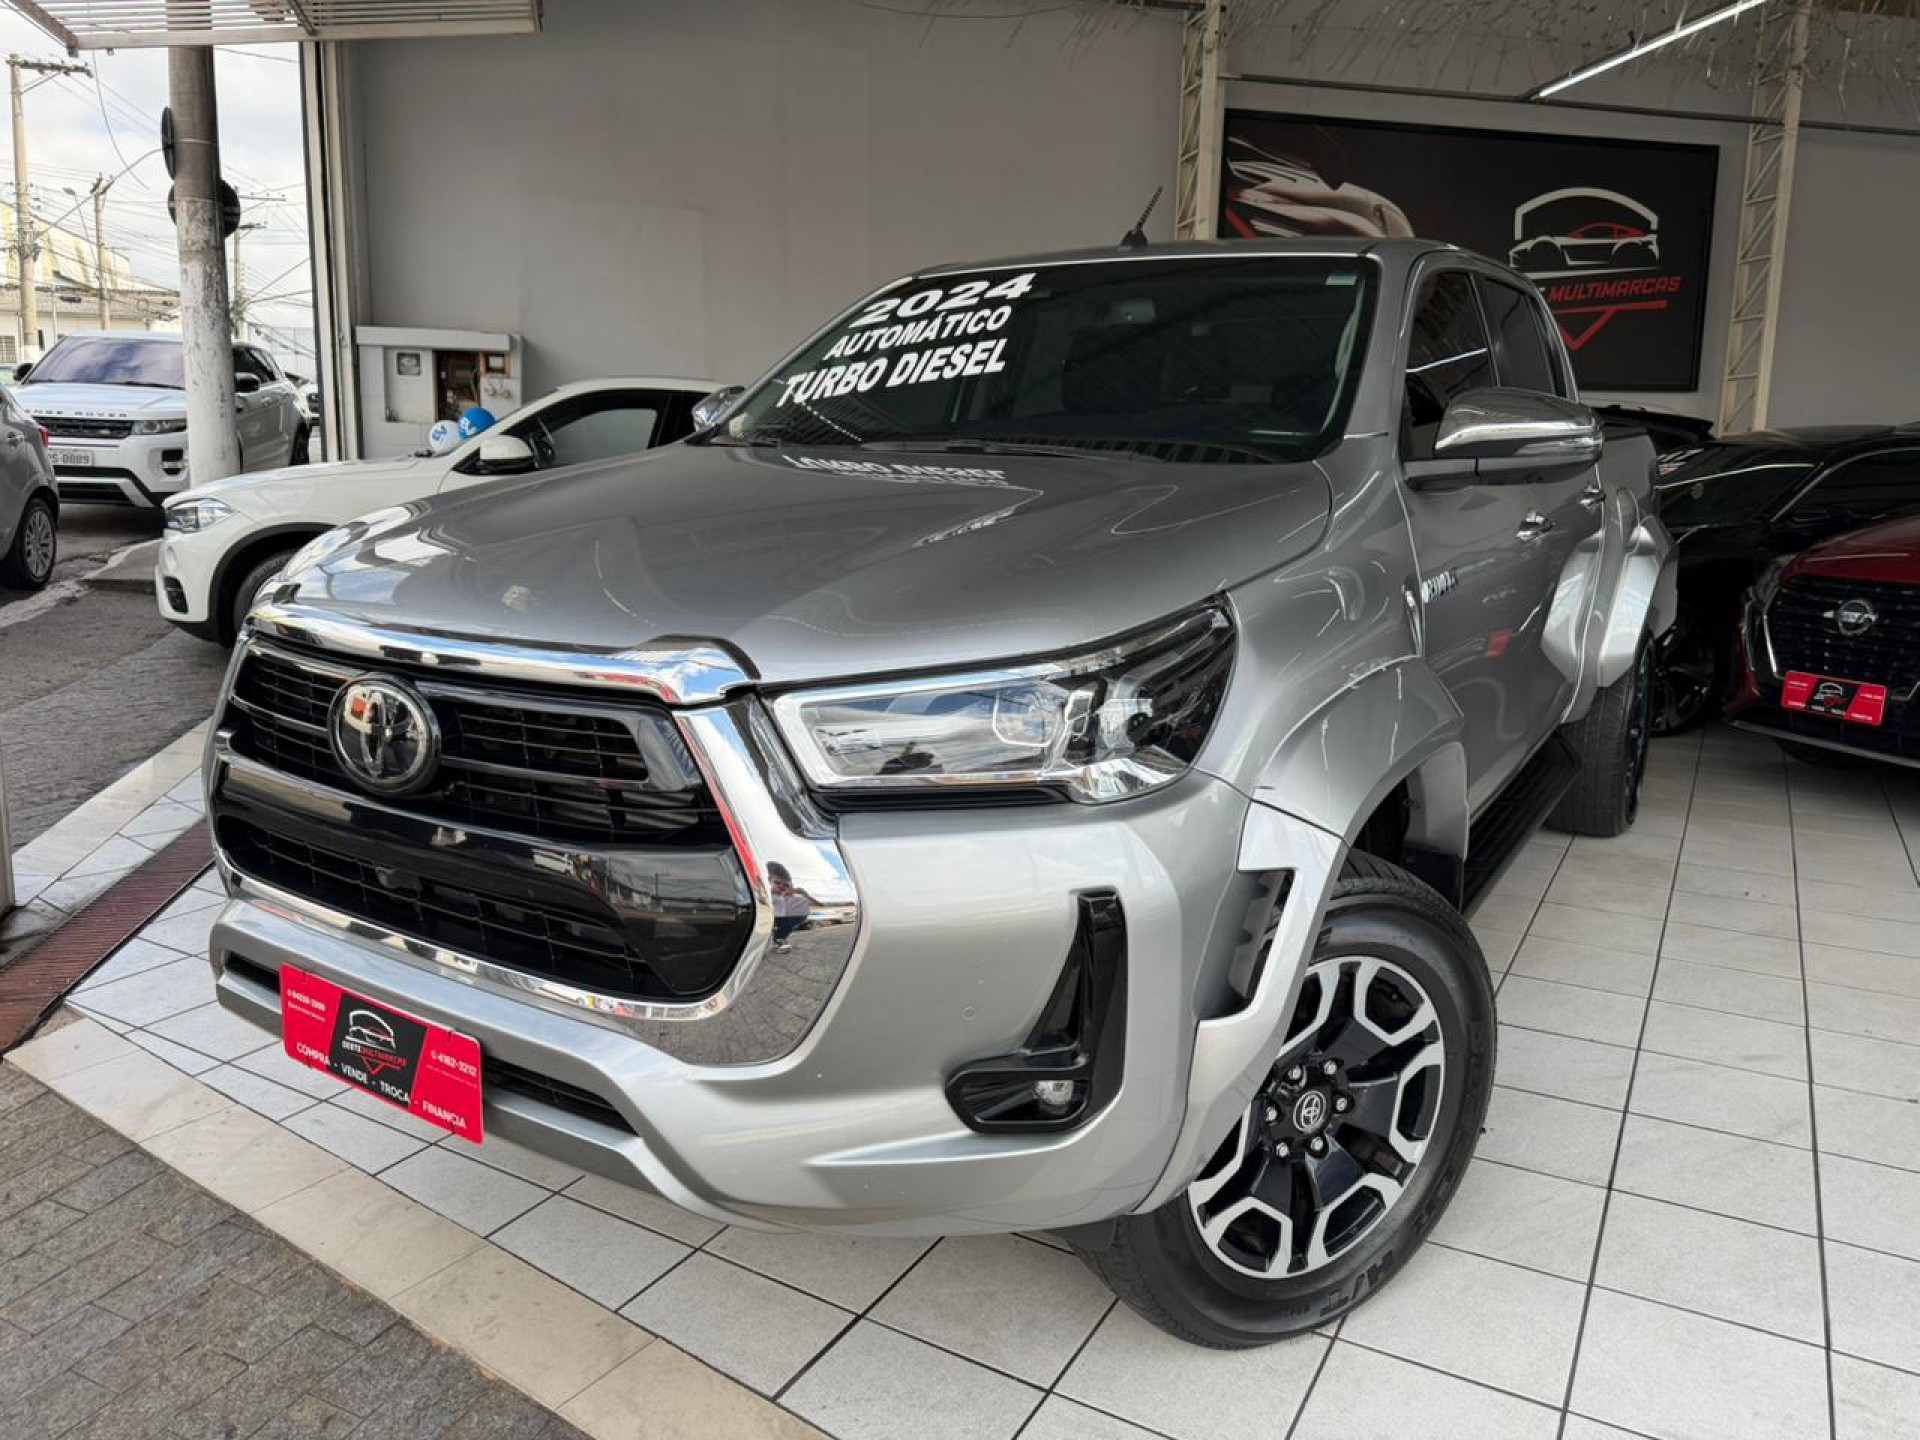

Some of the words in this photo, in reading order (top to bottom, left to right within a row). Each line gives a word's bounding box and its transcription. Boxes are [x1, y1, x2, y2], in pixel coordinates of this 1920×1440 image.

[848, 273, 1037, 328] 2024
[1549, 275, 1681, 301] MULTIMARCAS
[822, 305, 1012, 361] AUTOMÁTICO
[775, 357, 889, 408] TURBO
[885, 338, 1008, 388] DIESEL
[296, 1043, 330, 1066] COMPRA
[341, 1062, 367, 1085] VENDE
[380, 1080, 410, 1104] TROCA
[422, 1100, 466, 1129] FINANCIA
